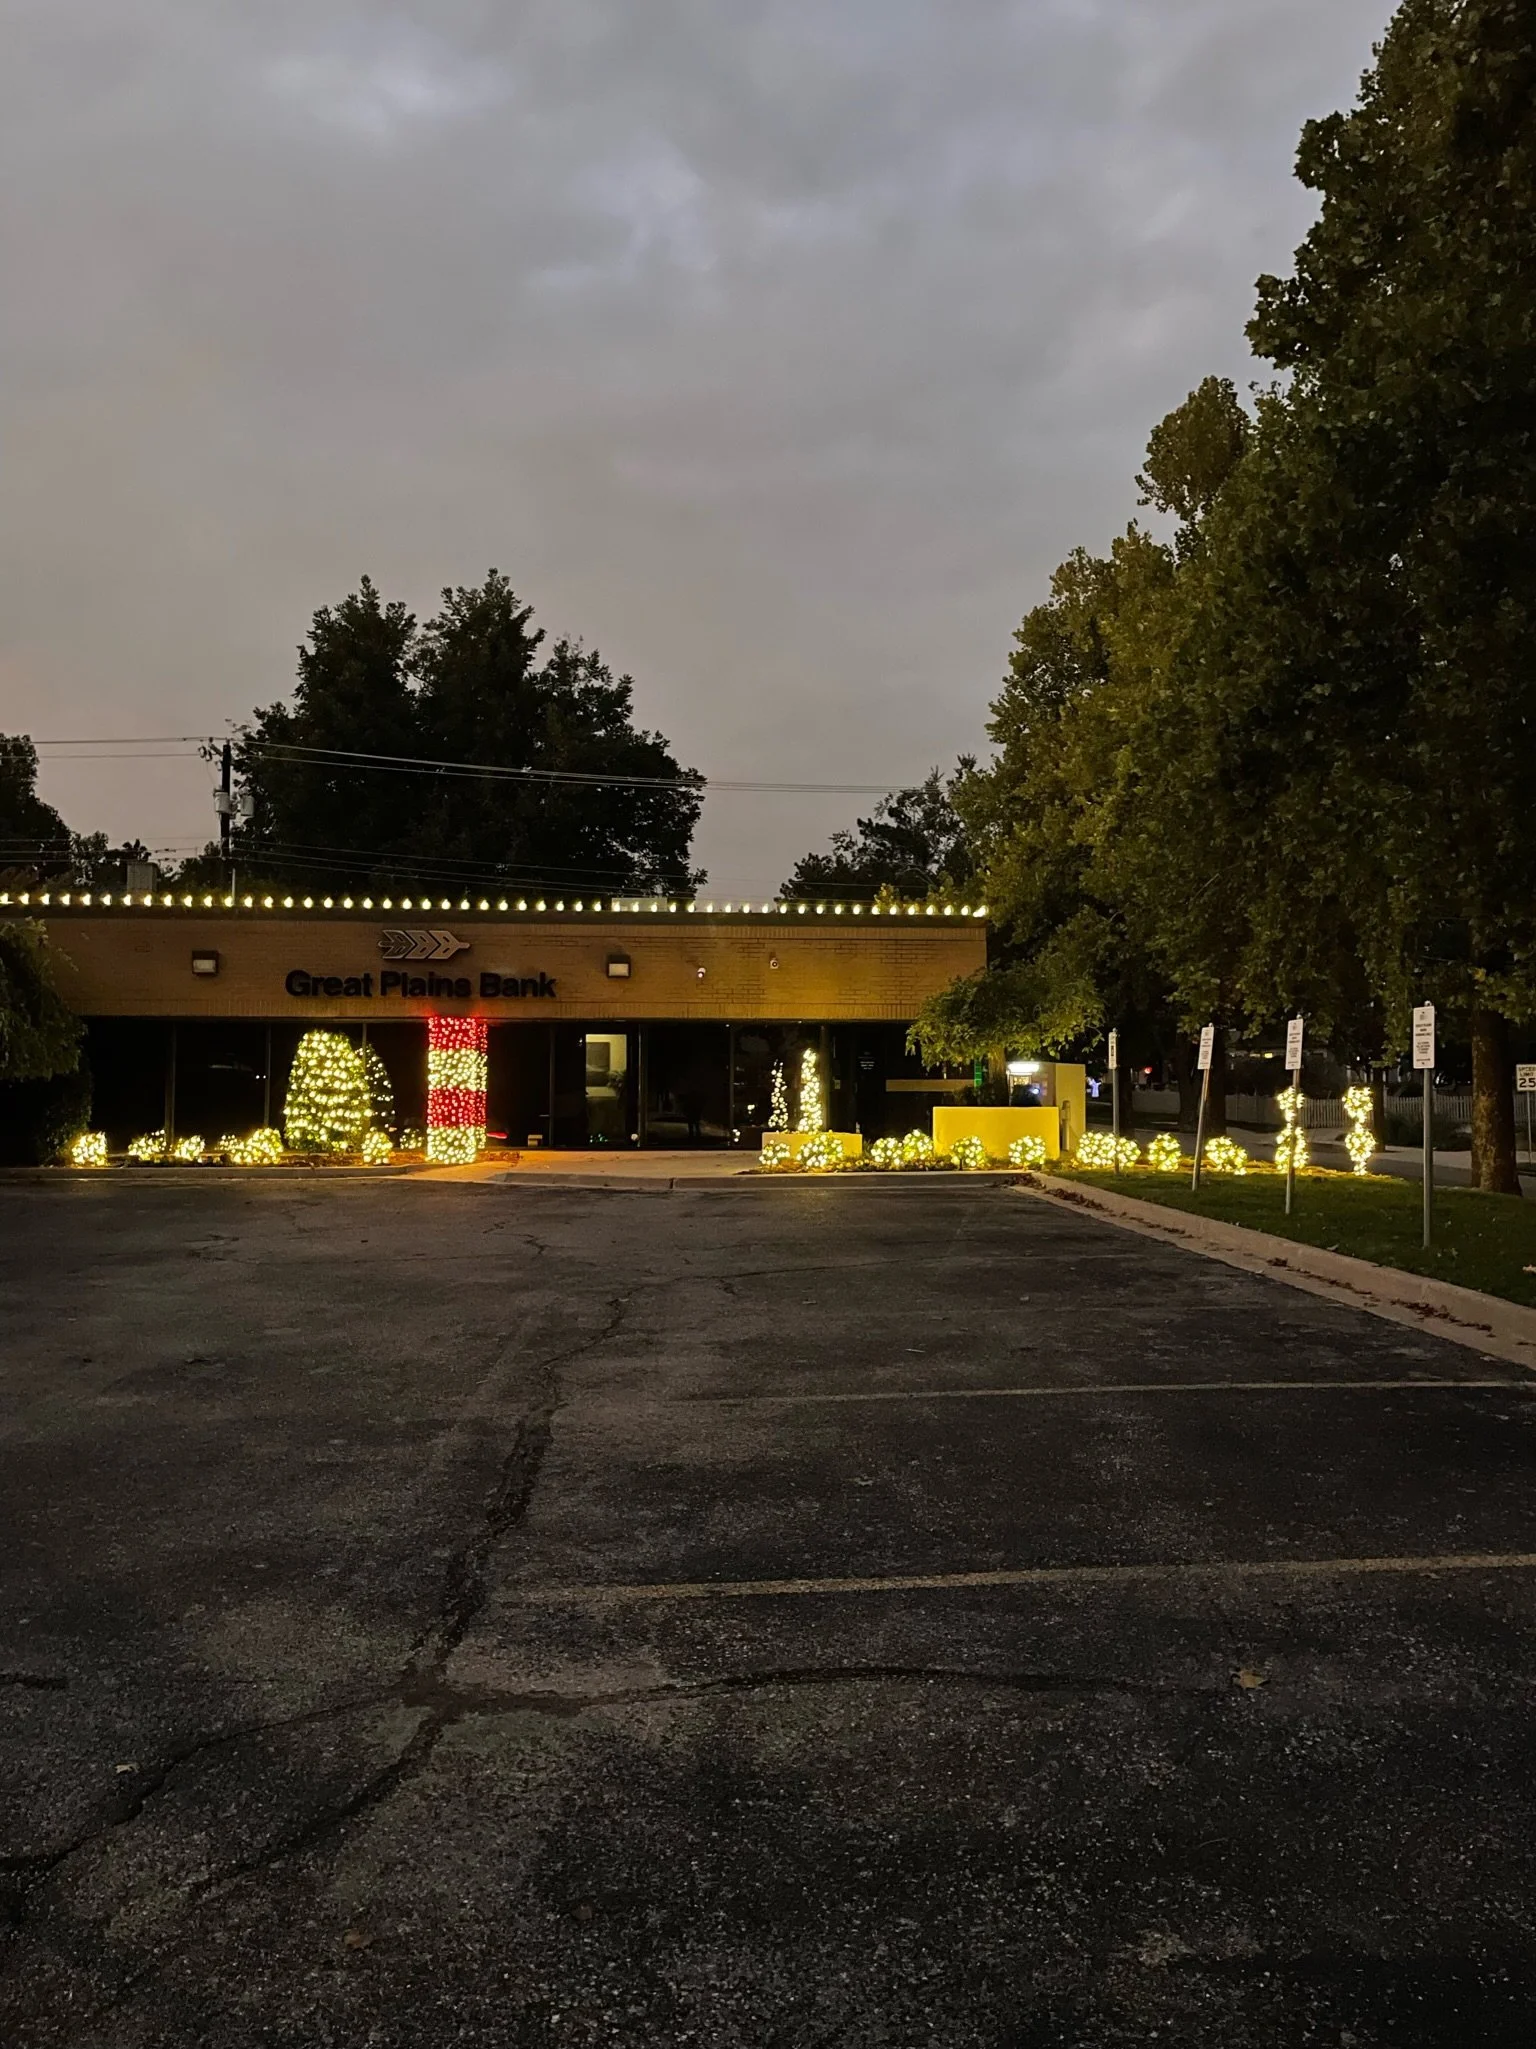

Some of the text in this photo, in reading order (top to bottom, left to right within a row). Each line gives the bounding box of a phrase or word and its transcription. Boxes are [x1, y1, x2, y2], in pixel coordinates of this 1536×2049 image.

[285, 969, 557, 998] Great Plains Bank
[1519, 1077, 1536, 1088] 25
